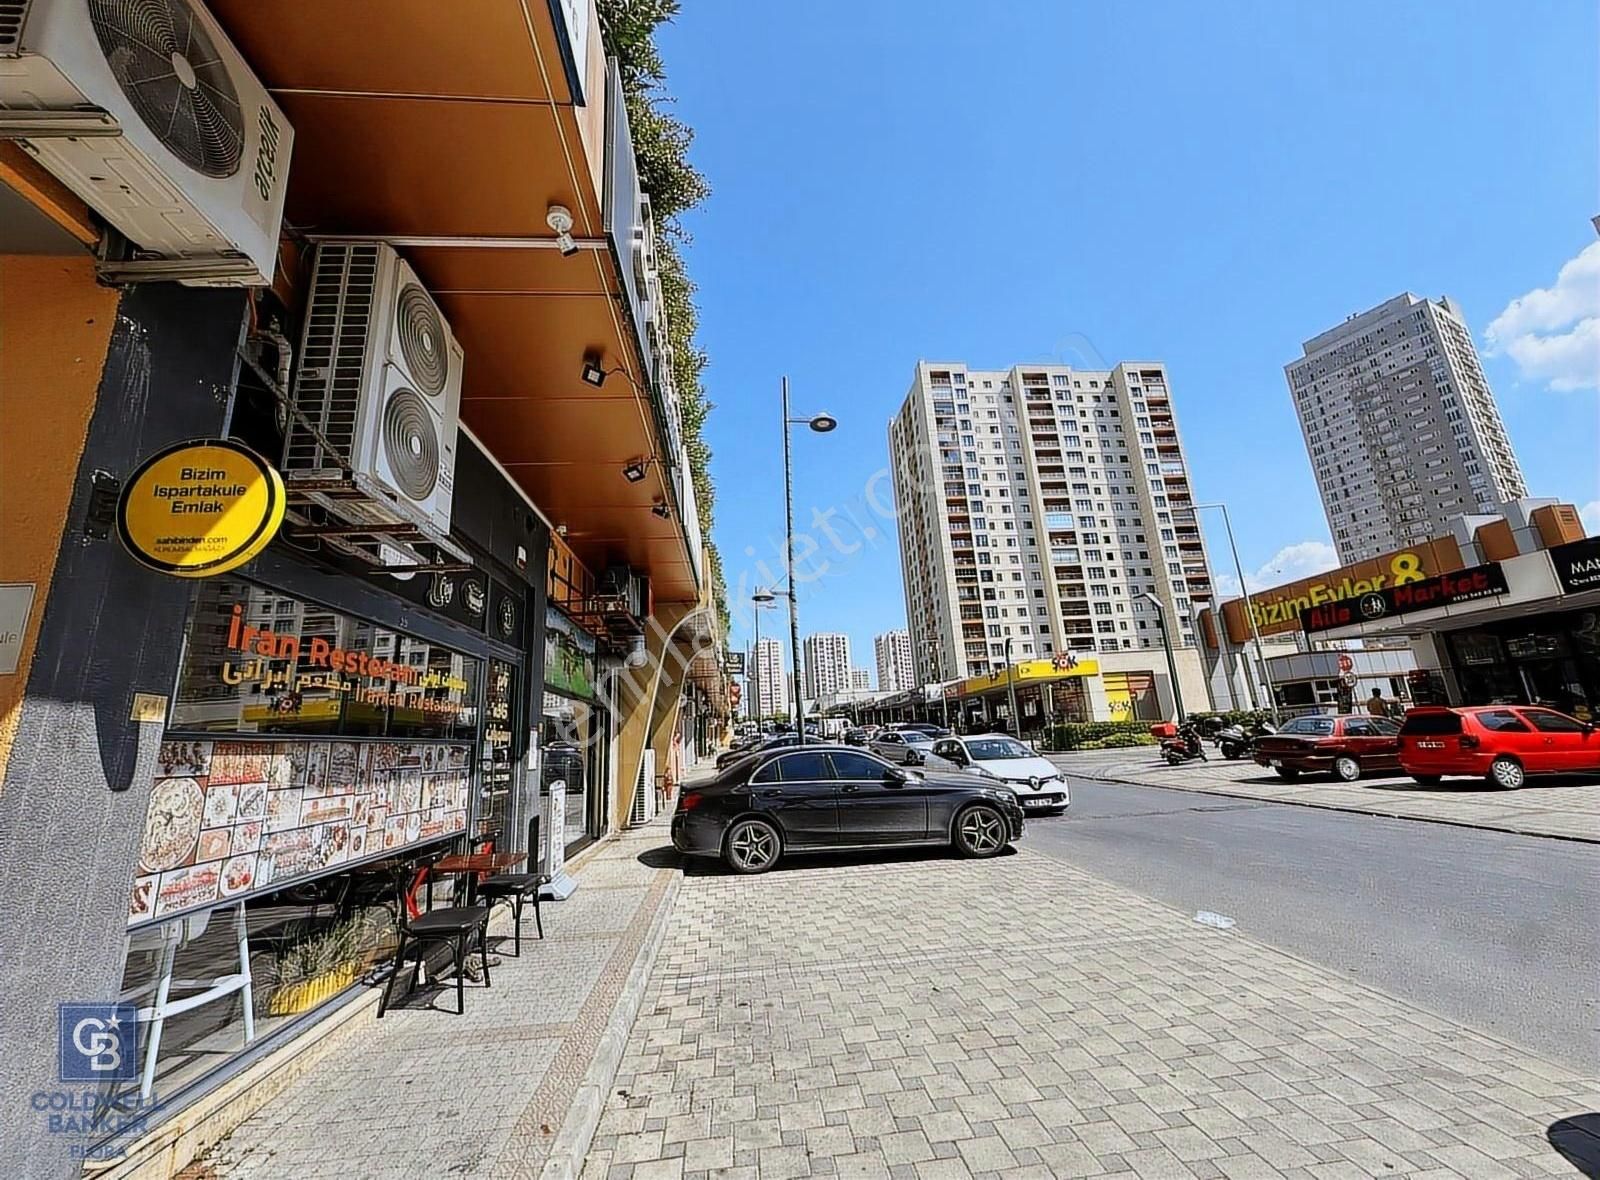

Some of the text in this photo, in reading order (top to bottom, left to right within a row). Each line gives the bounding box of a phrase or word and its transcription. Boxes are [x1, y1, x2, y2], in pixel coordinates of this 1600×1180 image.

[181, 468, 226, 481] Bizim
[172, 501, 224, 514] Emlak
[1390, 553, 1426, 587] 8
[1311, 571, 1489, 628] Aile Market
